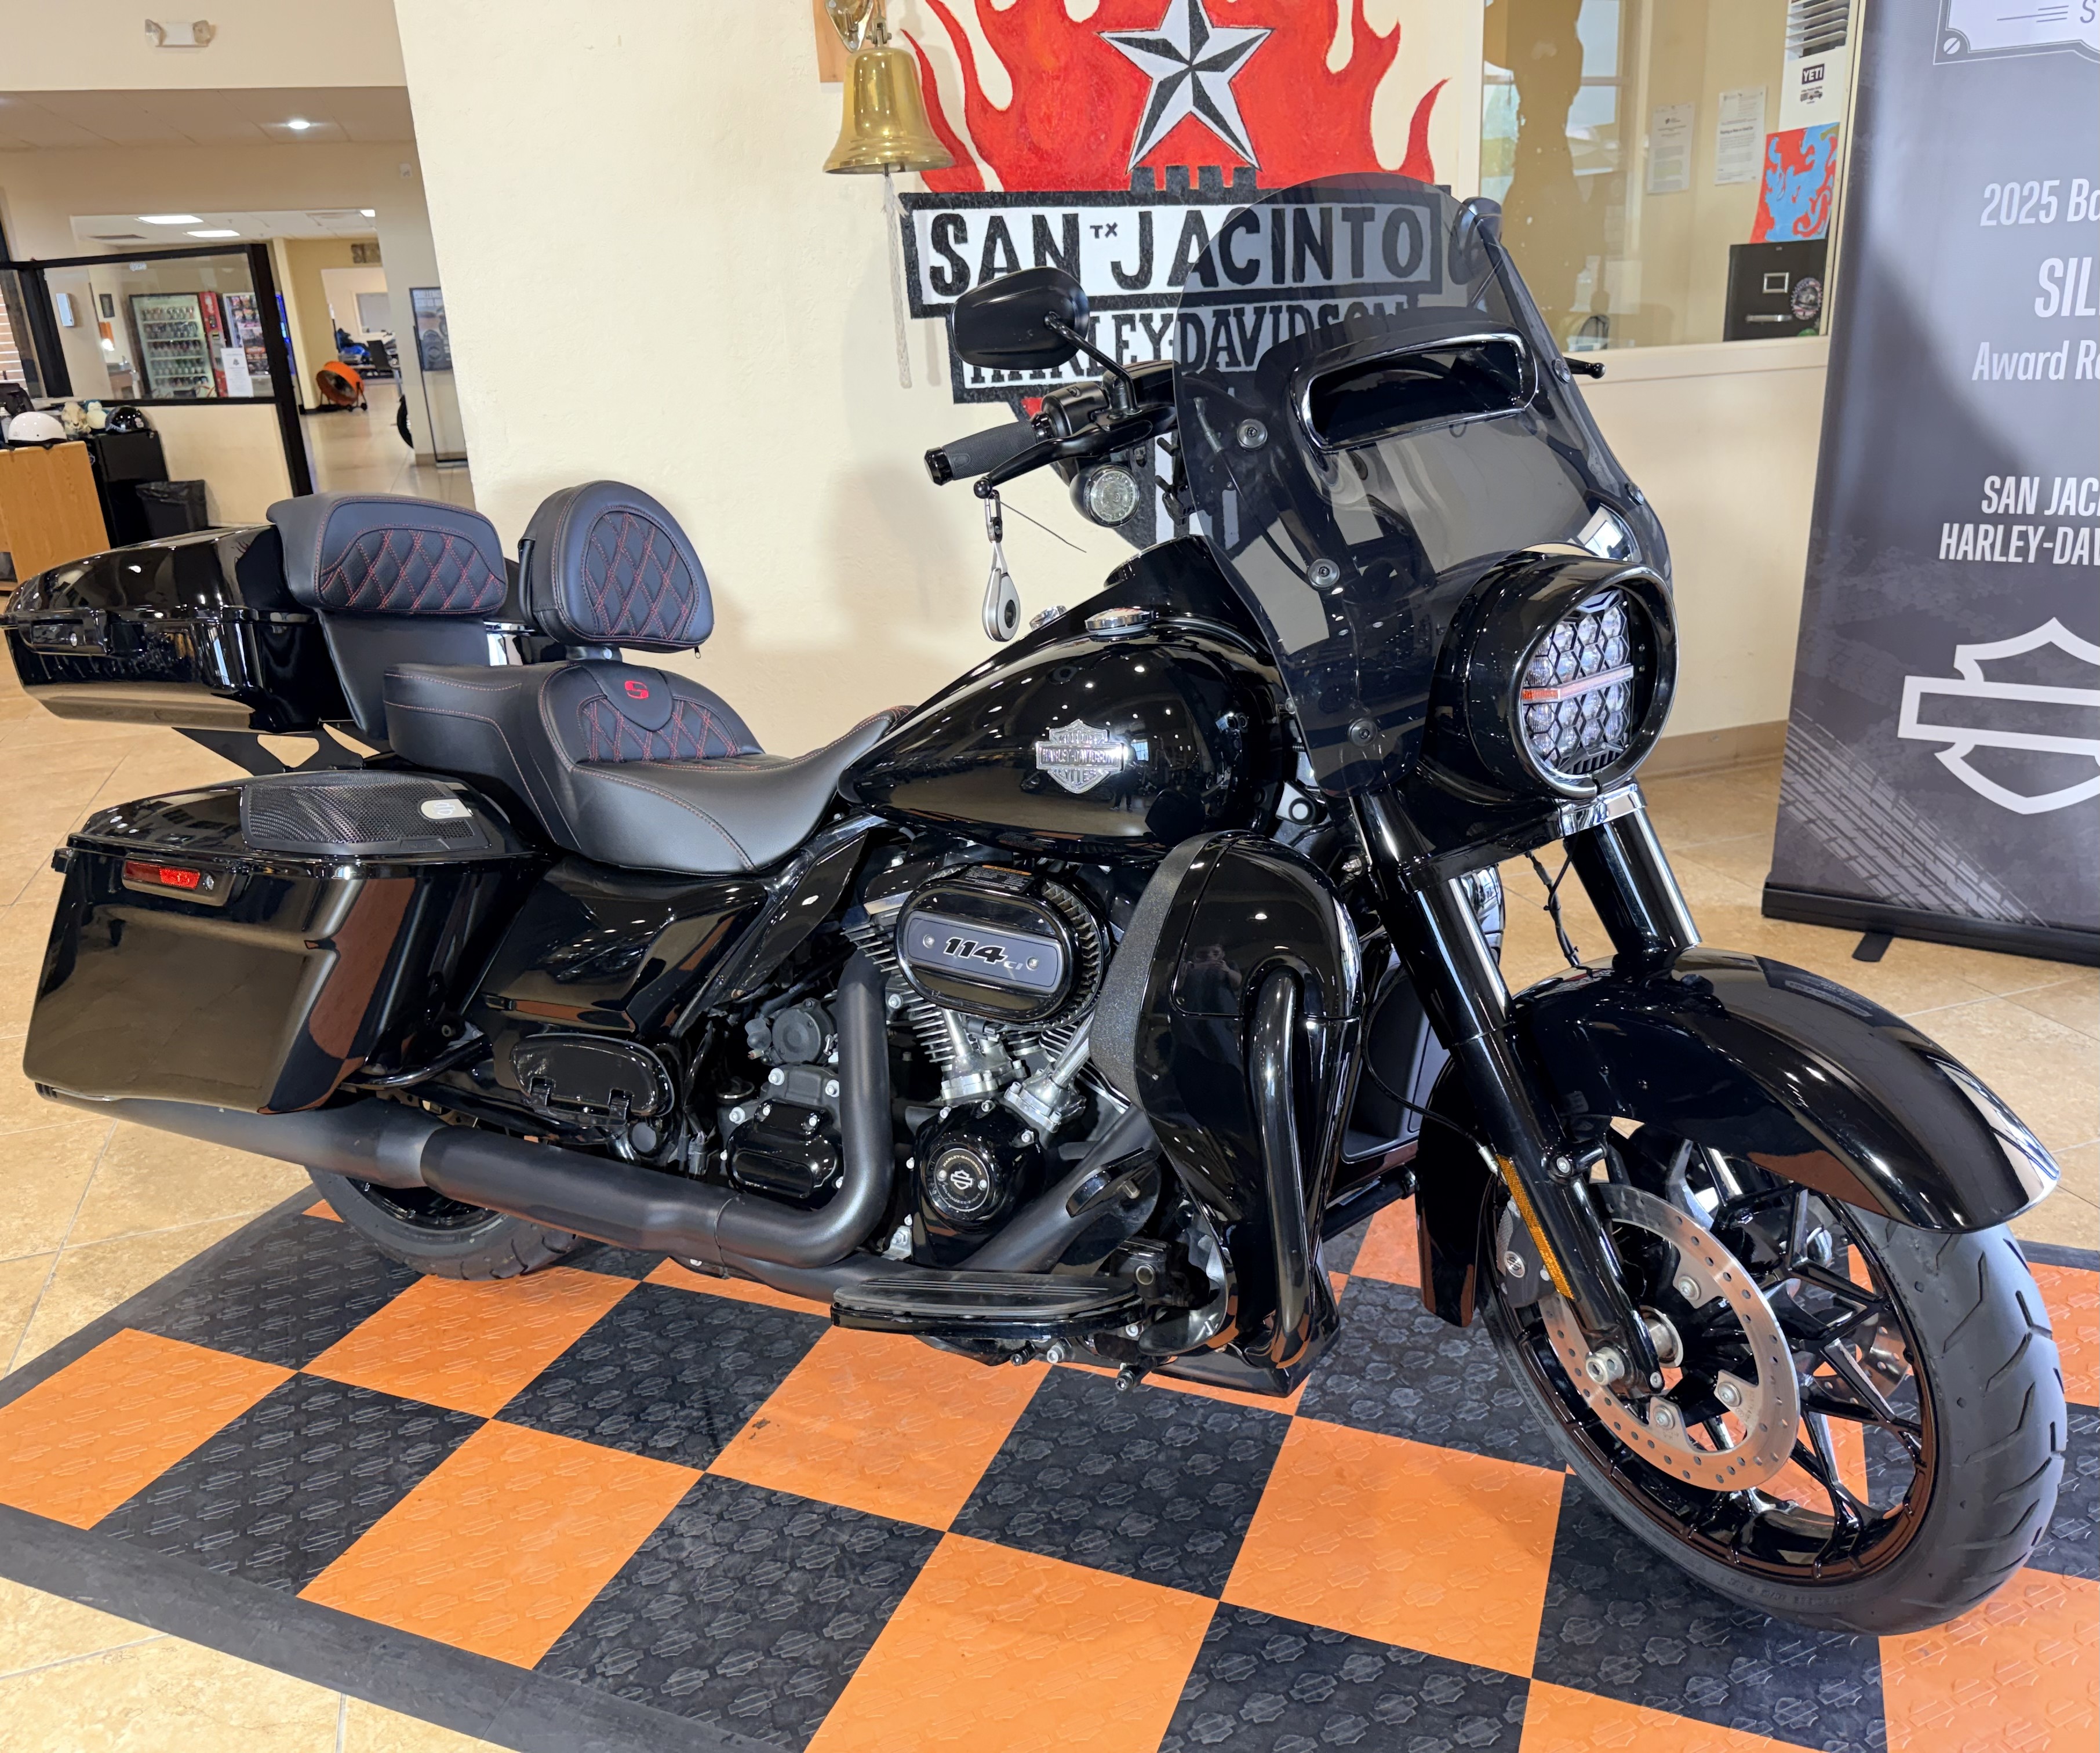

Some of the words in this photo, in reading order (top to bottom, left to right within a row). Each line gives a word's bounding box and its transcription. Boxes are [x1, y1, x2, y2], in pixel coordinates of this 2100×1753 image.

[1803, 66, 1823, 82] YETI
[1980, 180, 2060, 226] 2025
[930, 213, 1082, 297] SAN
[1090, 222, 1118, 239] TX
[1111, 207, 1423, 290] JACINTO
[2035, 257, 2100, 318] SIL
[1972, 340, 2069, 381] Award
[1981, 475, 2040, 515] SAN
[943, 937, 1008, 965] 114
[943, 1154, 982, 1176] HARLEY-DAVIDSON
